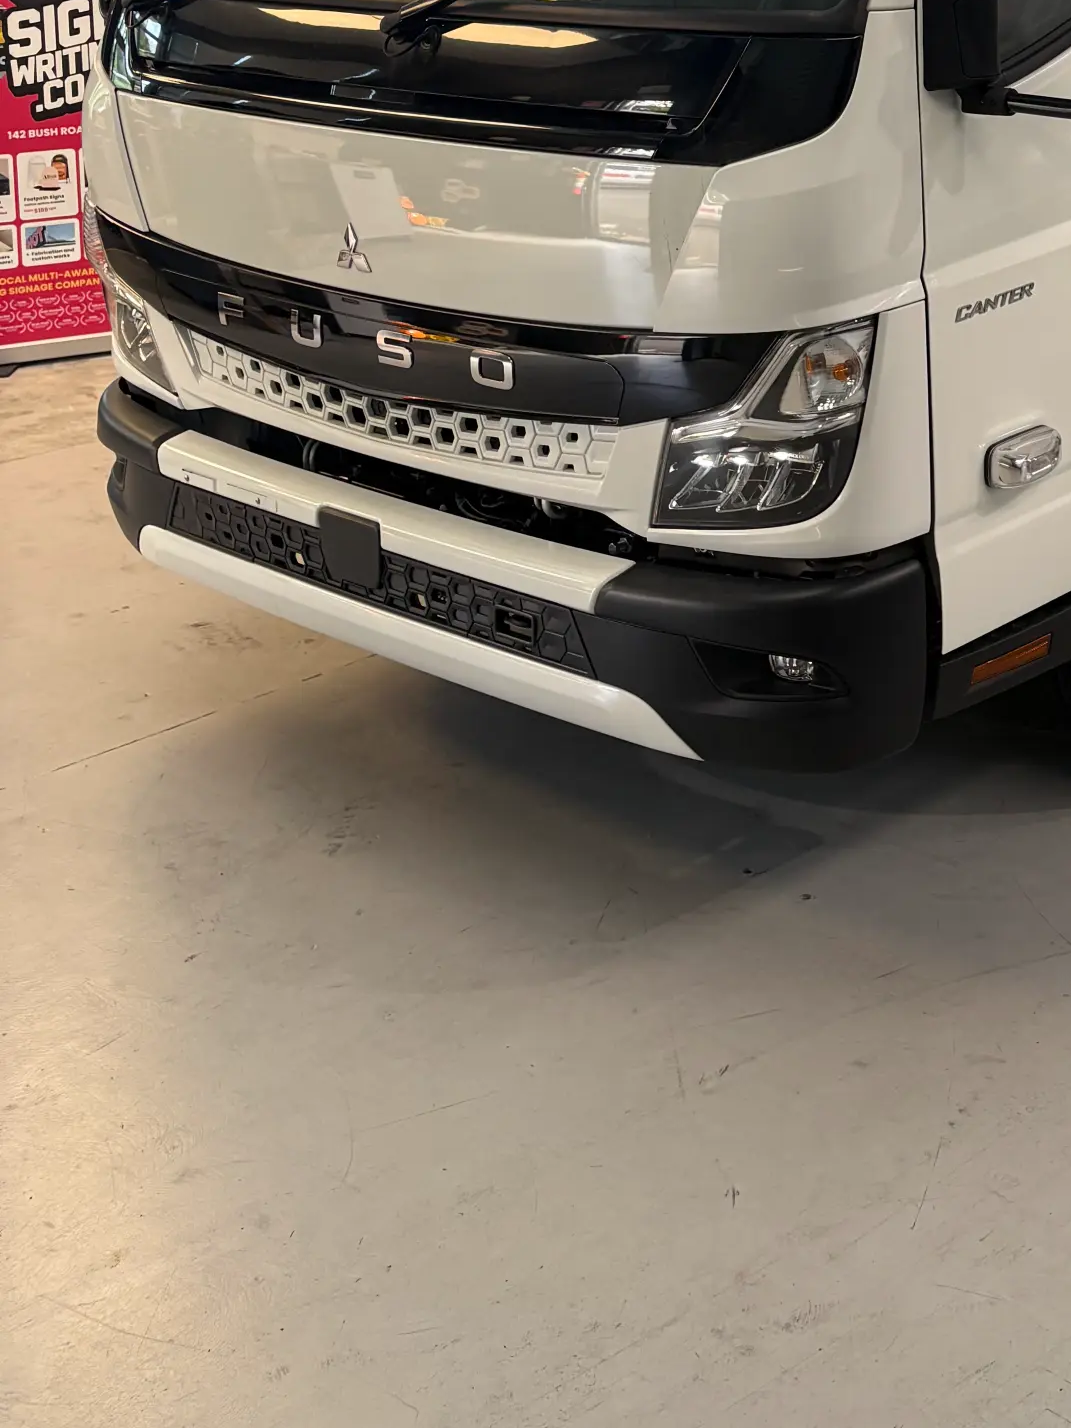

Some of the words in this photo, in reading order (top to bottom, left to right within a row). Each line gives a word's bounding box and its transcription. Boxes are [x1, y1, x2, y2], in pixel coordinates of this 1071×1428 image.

[7, 131, 26, 139] 142
[28, 127, 58, 138] BUSH
[28, 267, 99, 282] MULTI-AWAR
[8, 283, 54, 295] SIGNAGE
[954, 281, 1035, 324] CANTER
[217, 291, 516, 391] FUSO
